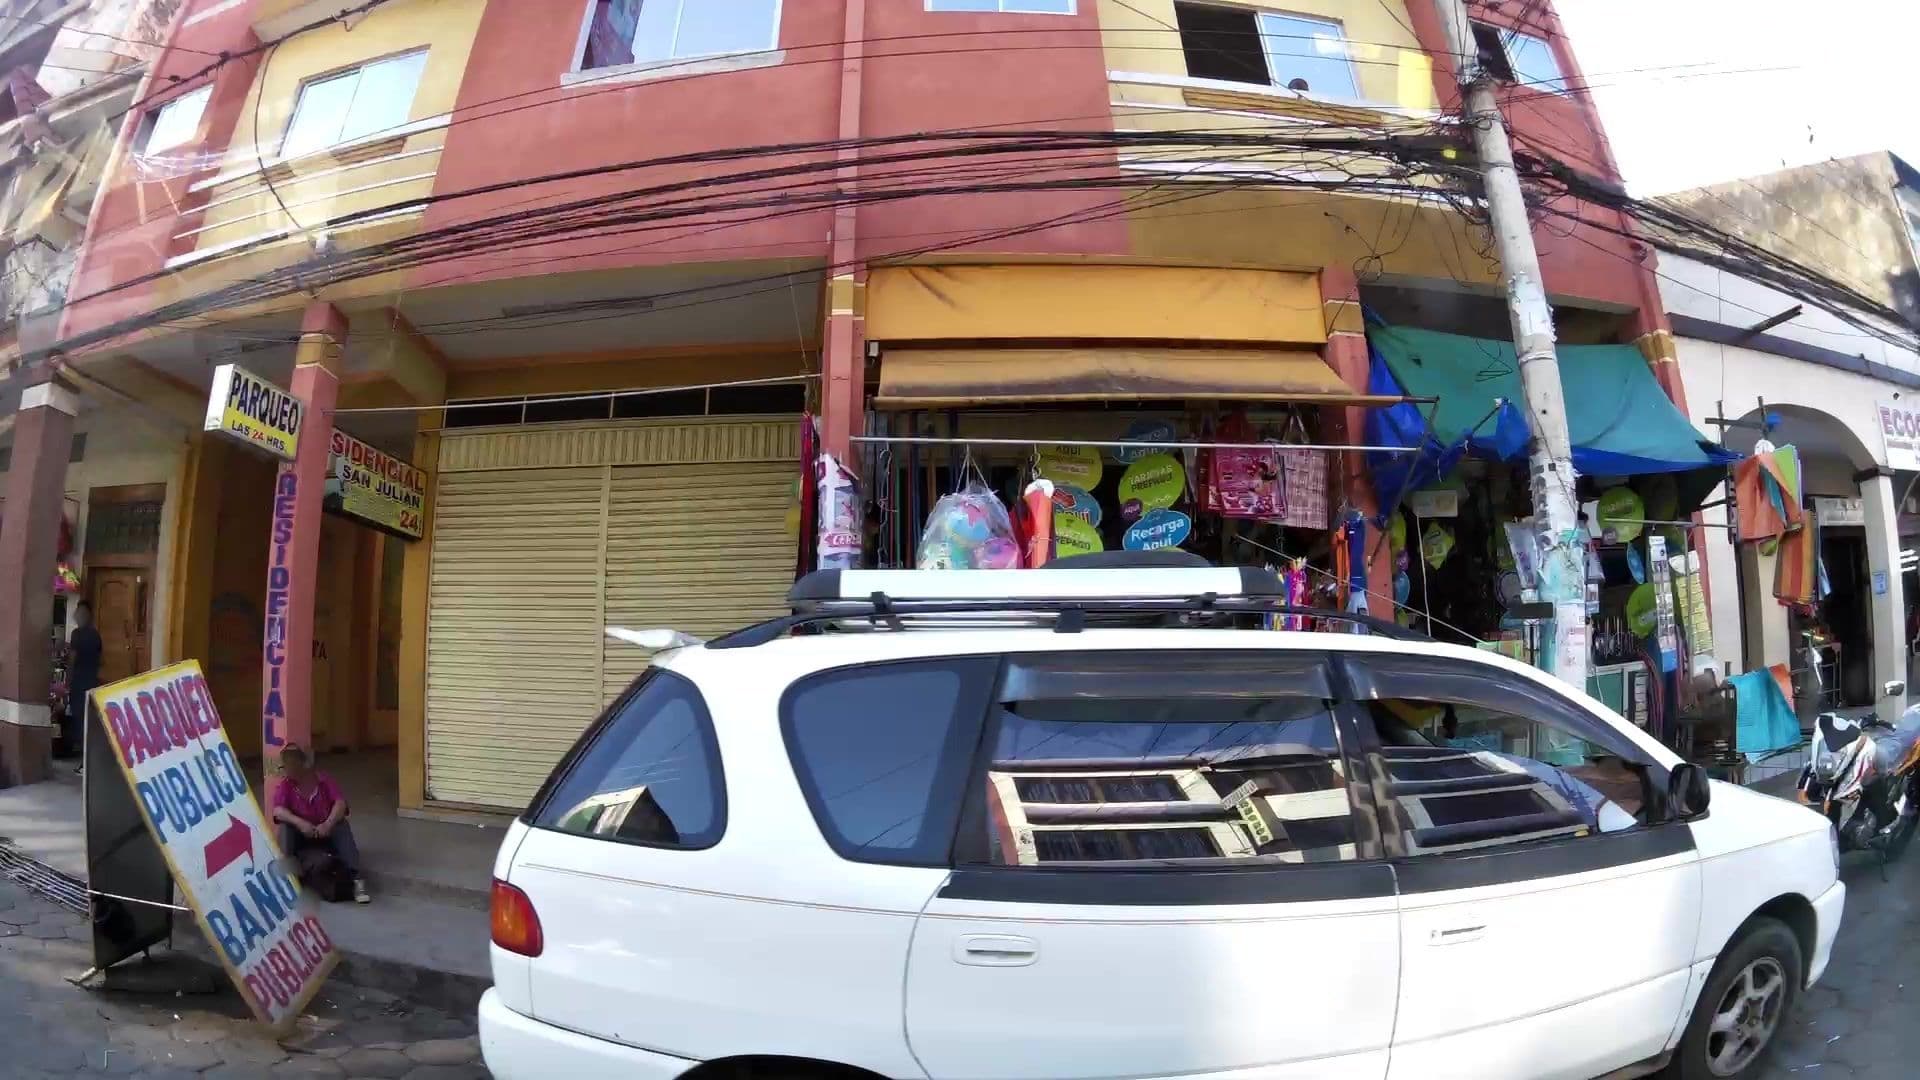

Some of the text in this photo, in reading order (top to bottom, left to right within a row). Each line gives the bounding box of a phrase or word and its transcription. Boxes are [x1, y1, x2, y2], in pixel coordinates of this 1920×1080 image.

[229, 371, 299, 436] PARQUEO
[231, 419, 250, 437] LAS
[251, 429, 264, 441] 24
[327, 431, 424, 496] SIDENCIAL
[342, 464, 370, 489] SAN
[376, 480, 420, 509] JULIAN
[1131, 518, 1184, 542] Recarga
[104, 674, 219, 768] PARQUEO
[136, 742, 247, 844] PUBLICO
[244, 915, 331, 1024] PUBLICO
